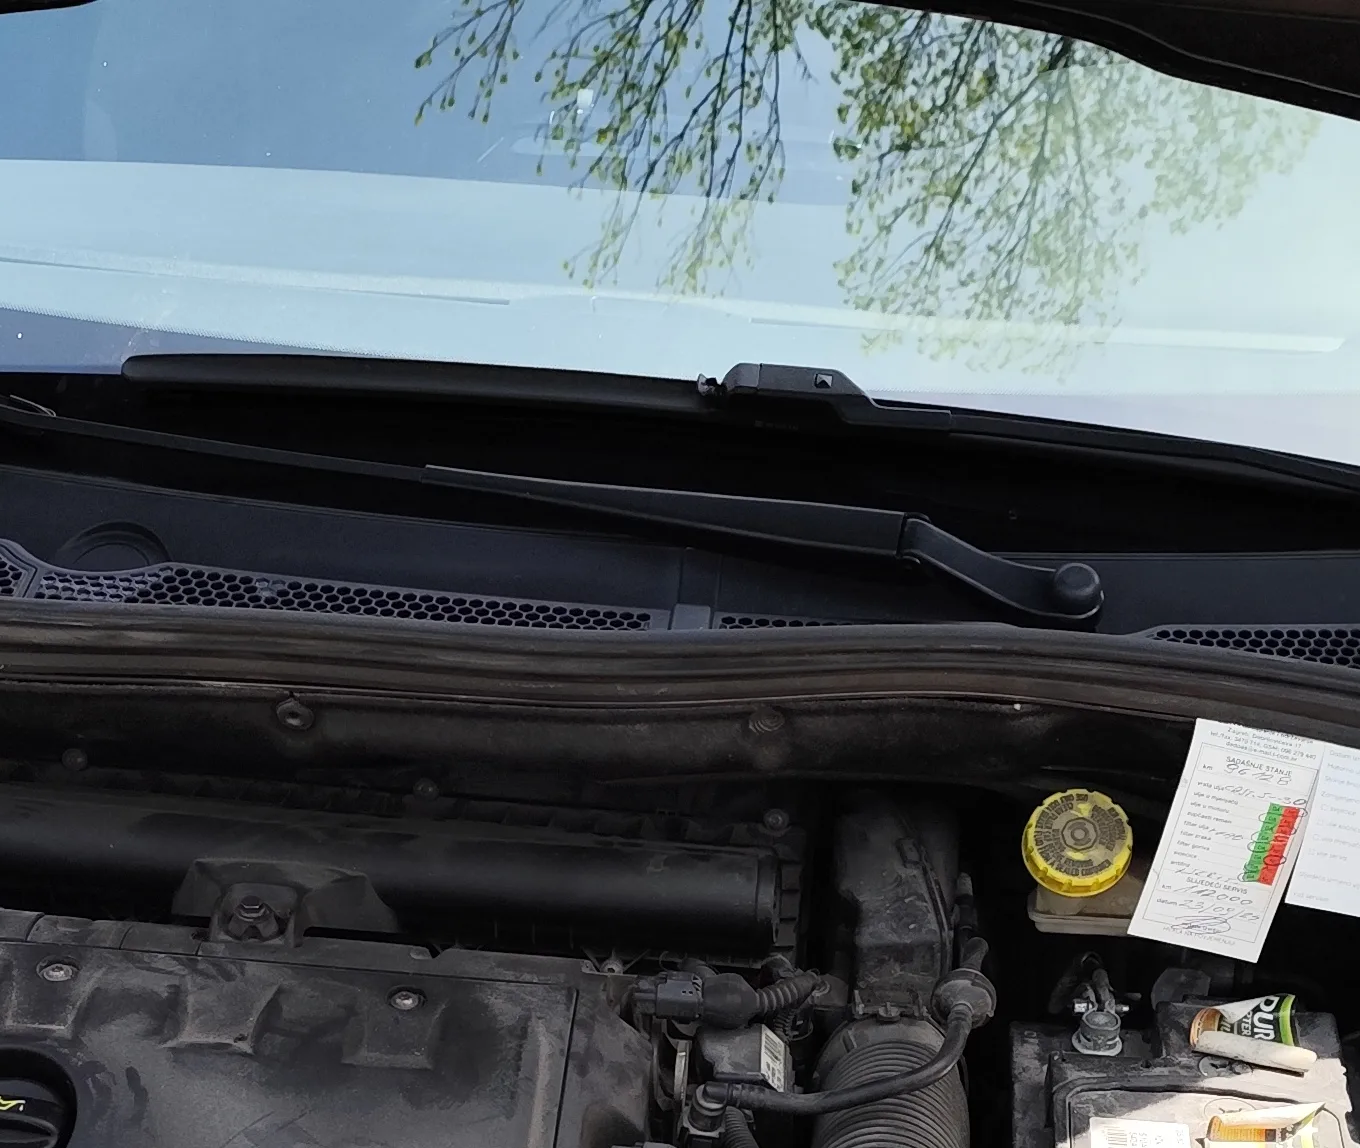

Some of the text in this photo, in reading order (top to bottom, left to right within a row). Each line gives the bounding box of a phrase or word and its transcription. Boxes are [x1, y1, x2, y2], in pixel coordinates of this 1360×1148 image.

[1226, 756, 1291, 777] SADAŠNJE STANJE
[1222, 884, 1247, 894] SERVIS
